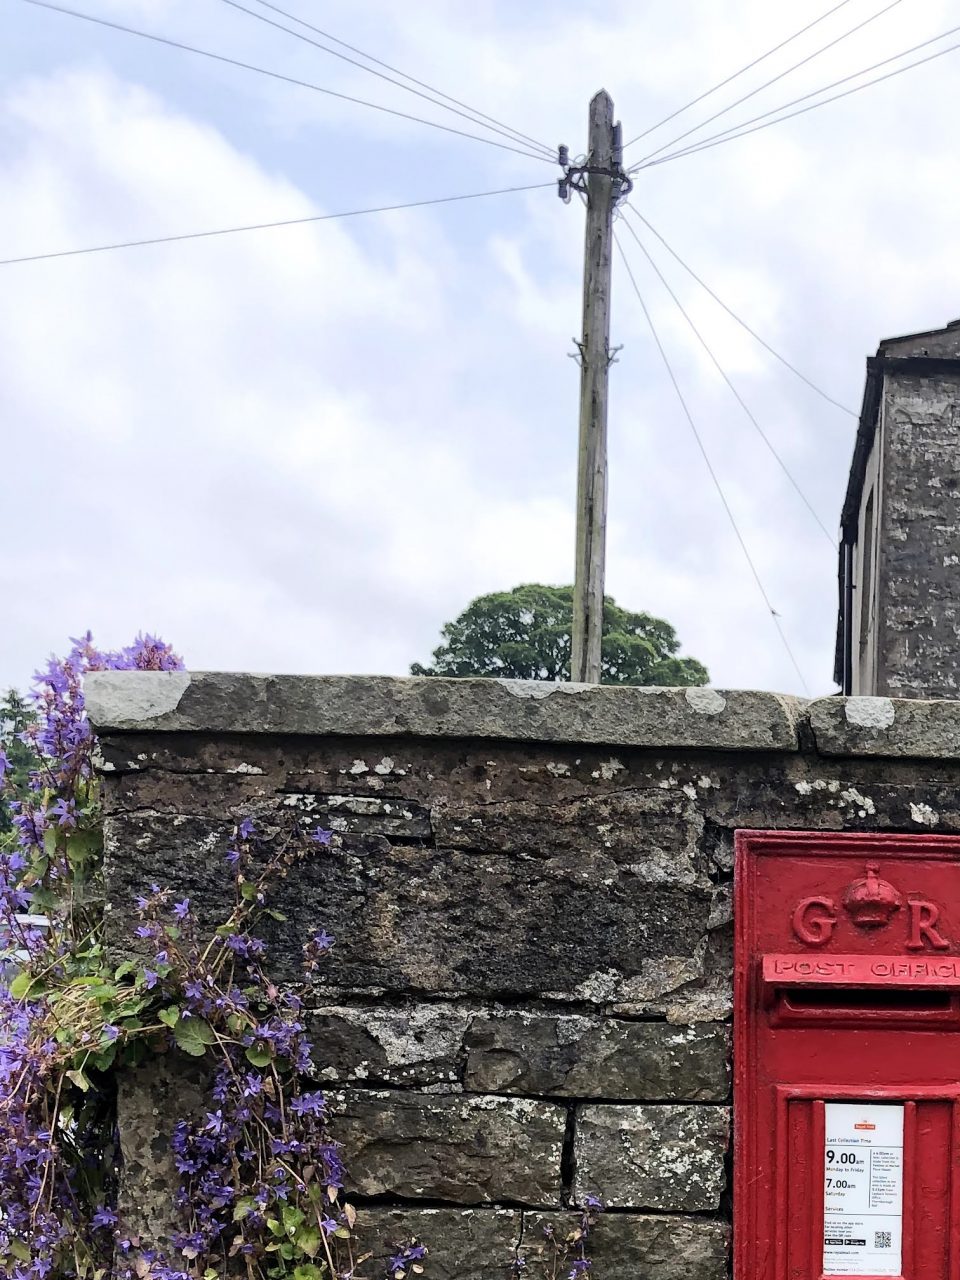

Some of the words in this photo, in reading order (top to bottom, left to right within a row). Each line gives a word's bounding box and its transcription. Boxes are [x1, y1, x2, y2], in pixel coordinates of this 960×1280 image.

[792, 895, 837, 946] G
[906, 899, 951, 950] R
[773, 959, 853, 976] POST
[826, 1150, 864, 1165] 9.00am
[826, 1178, 856, 1189] 7.00am
